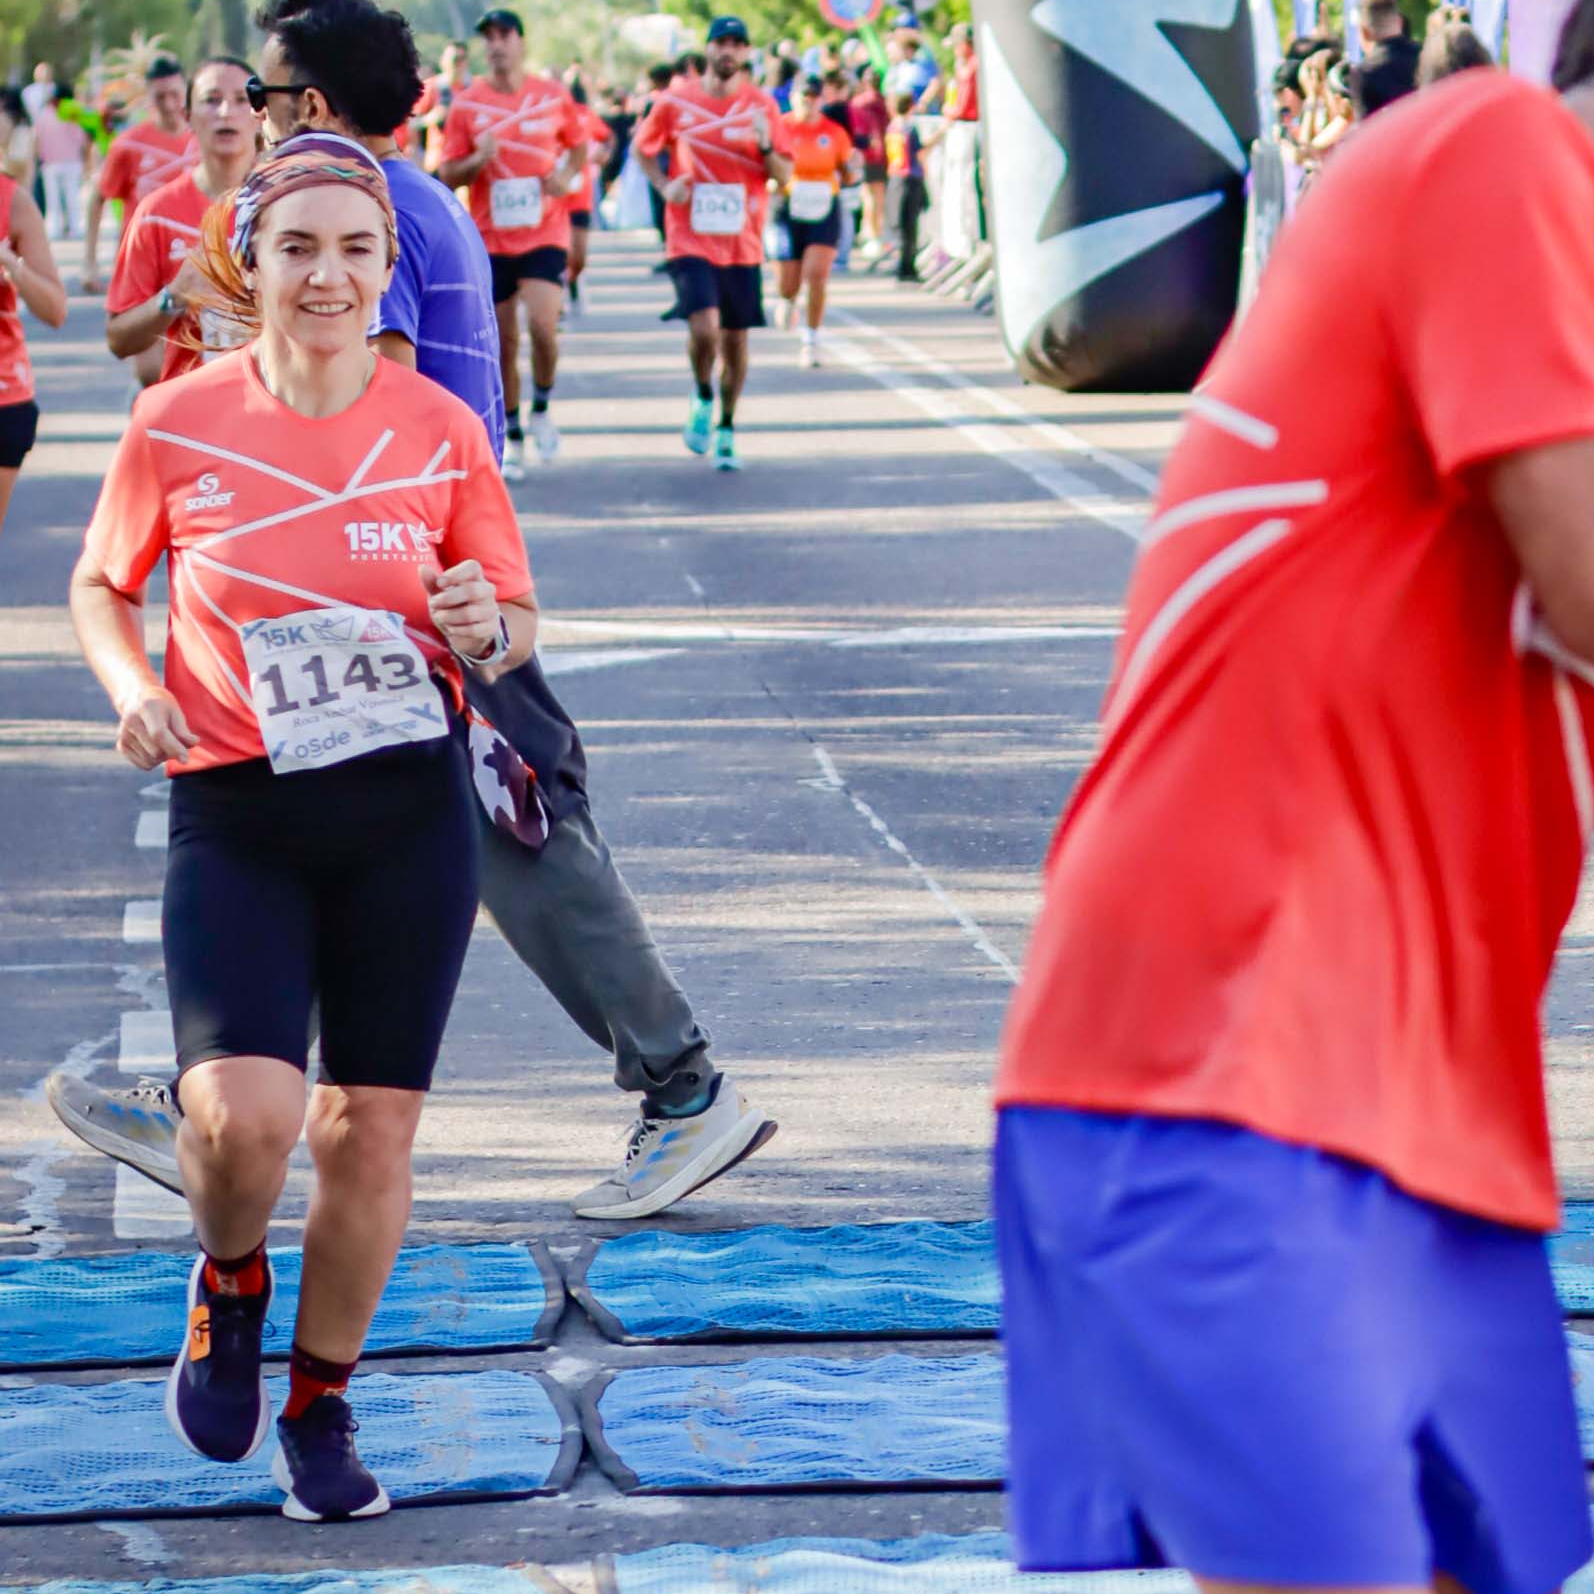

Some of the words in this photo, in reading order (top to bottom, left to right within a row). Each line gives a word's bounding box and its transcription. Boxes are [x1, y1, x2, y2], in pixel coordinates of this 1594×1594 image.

[344, 521, 407, 551] 15K
[258, 624, 309, 649] 15K
[260, 653, 422, 717] 1143
[295, 730, 351, 759] osde
